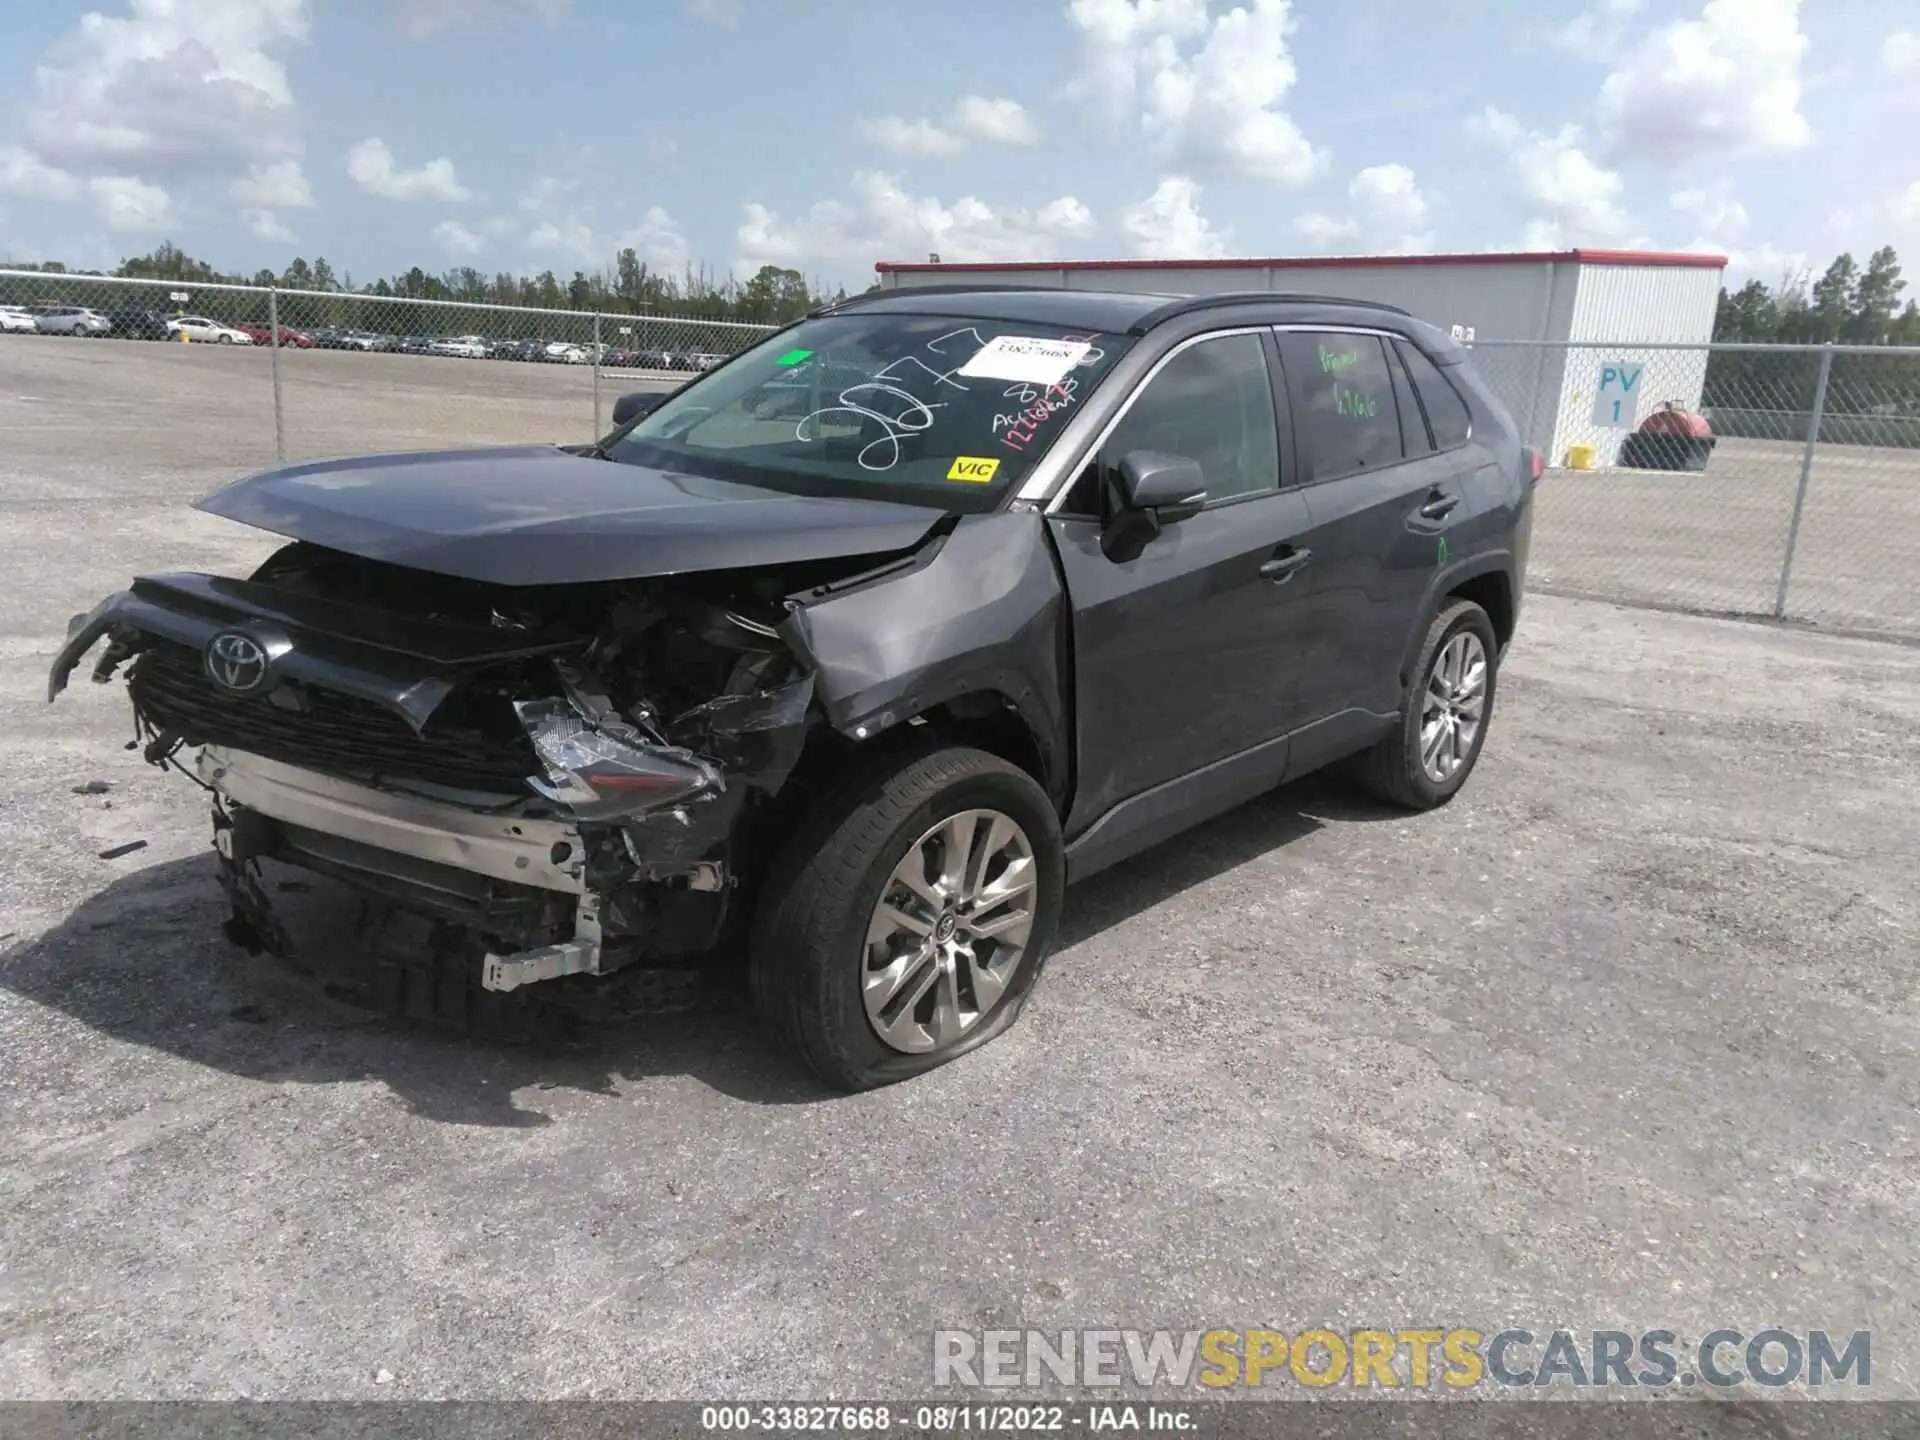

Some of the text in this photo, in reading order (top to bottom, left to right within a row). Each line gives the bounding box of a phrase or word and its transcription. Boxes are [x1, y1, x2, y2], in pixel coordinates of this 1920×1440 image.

[1600, 367, 1640, 392] PV
[1612, 399, 1621, 423] 1
[957, 463, 993, 477] VIC
